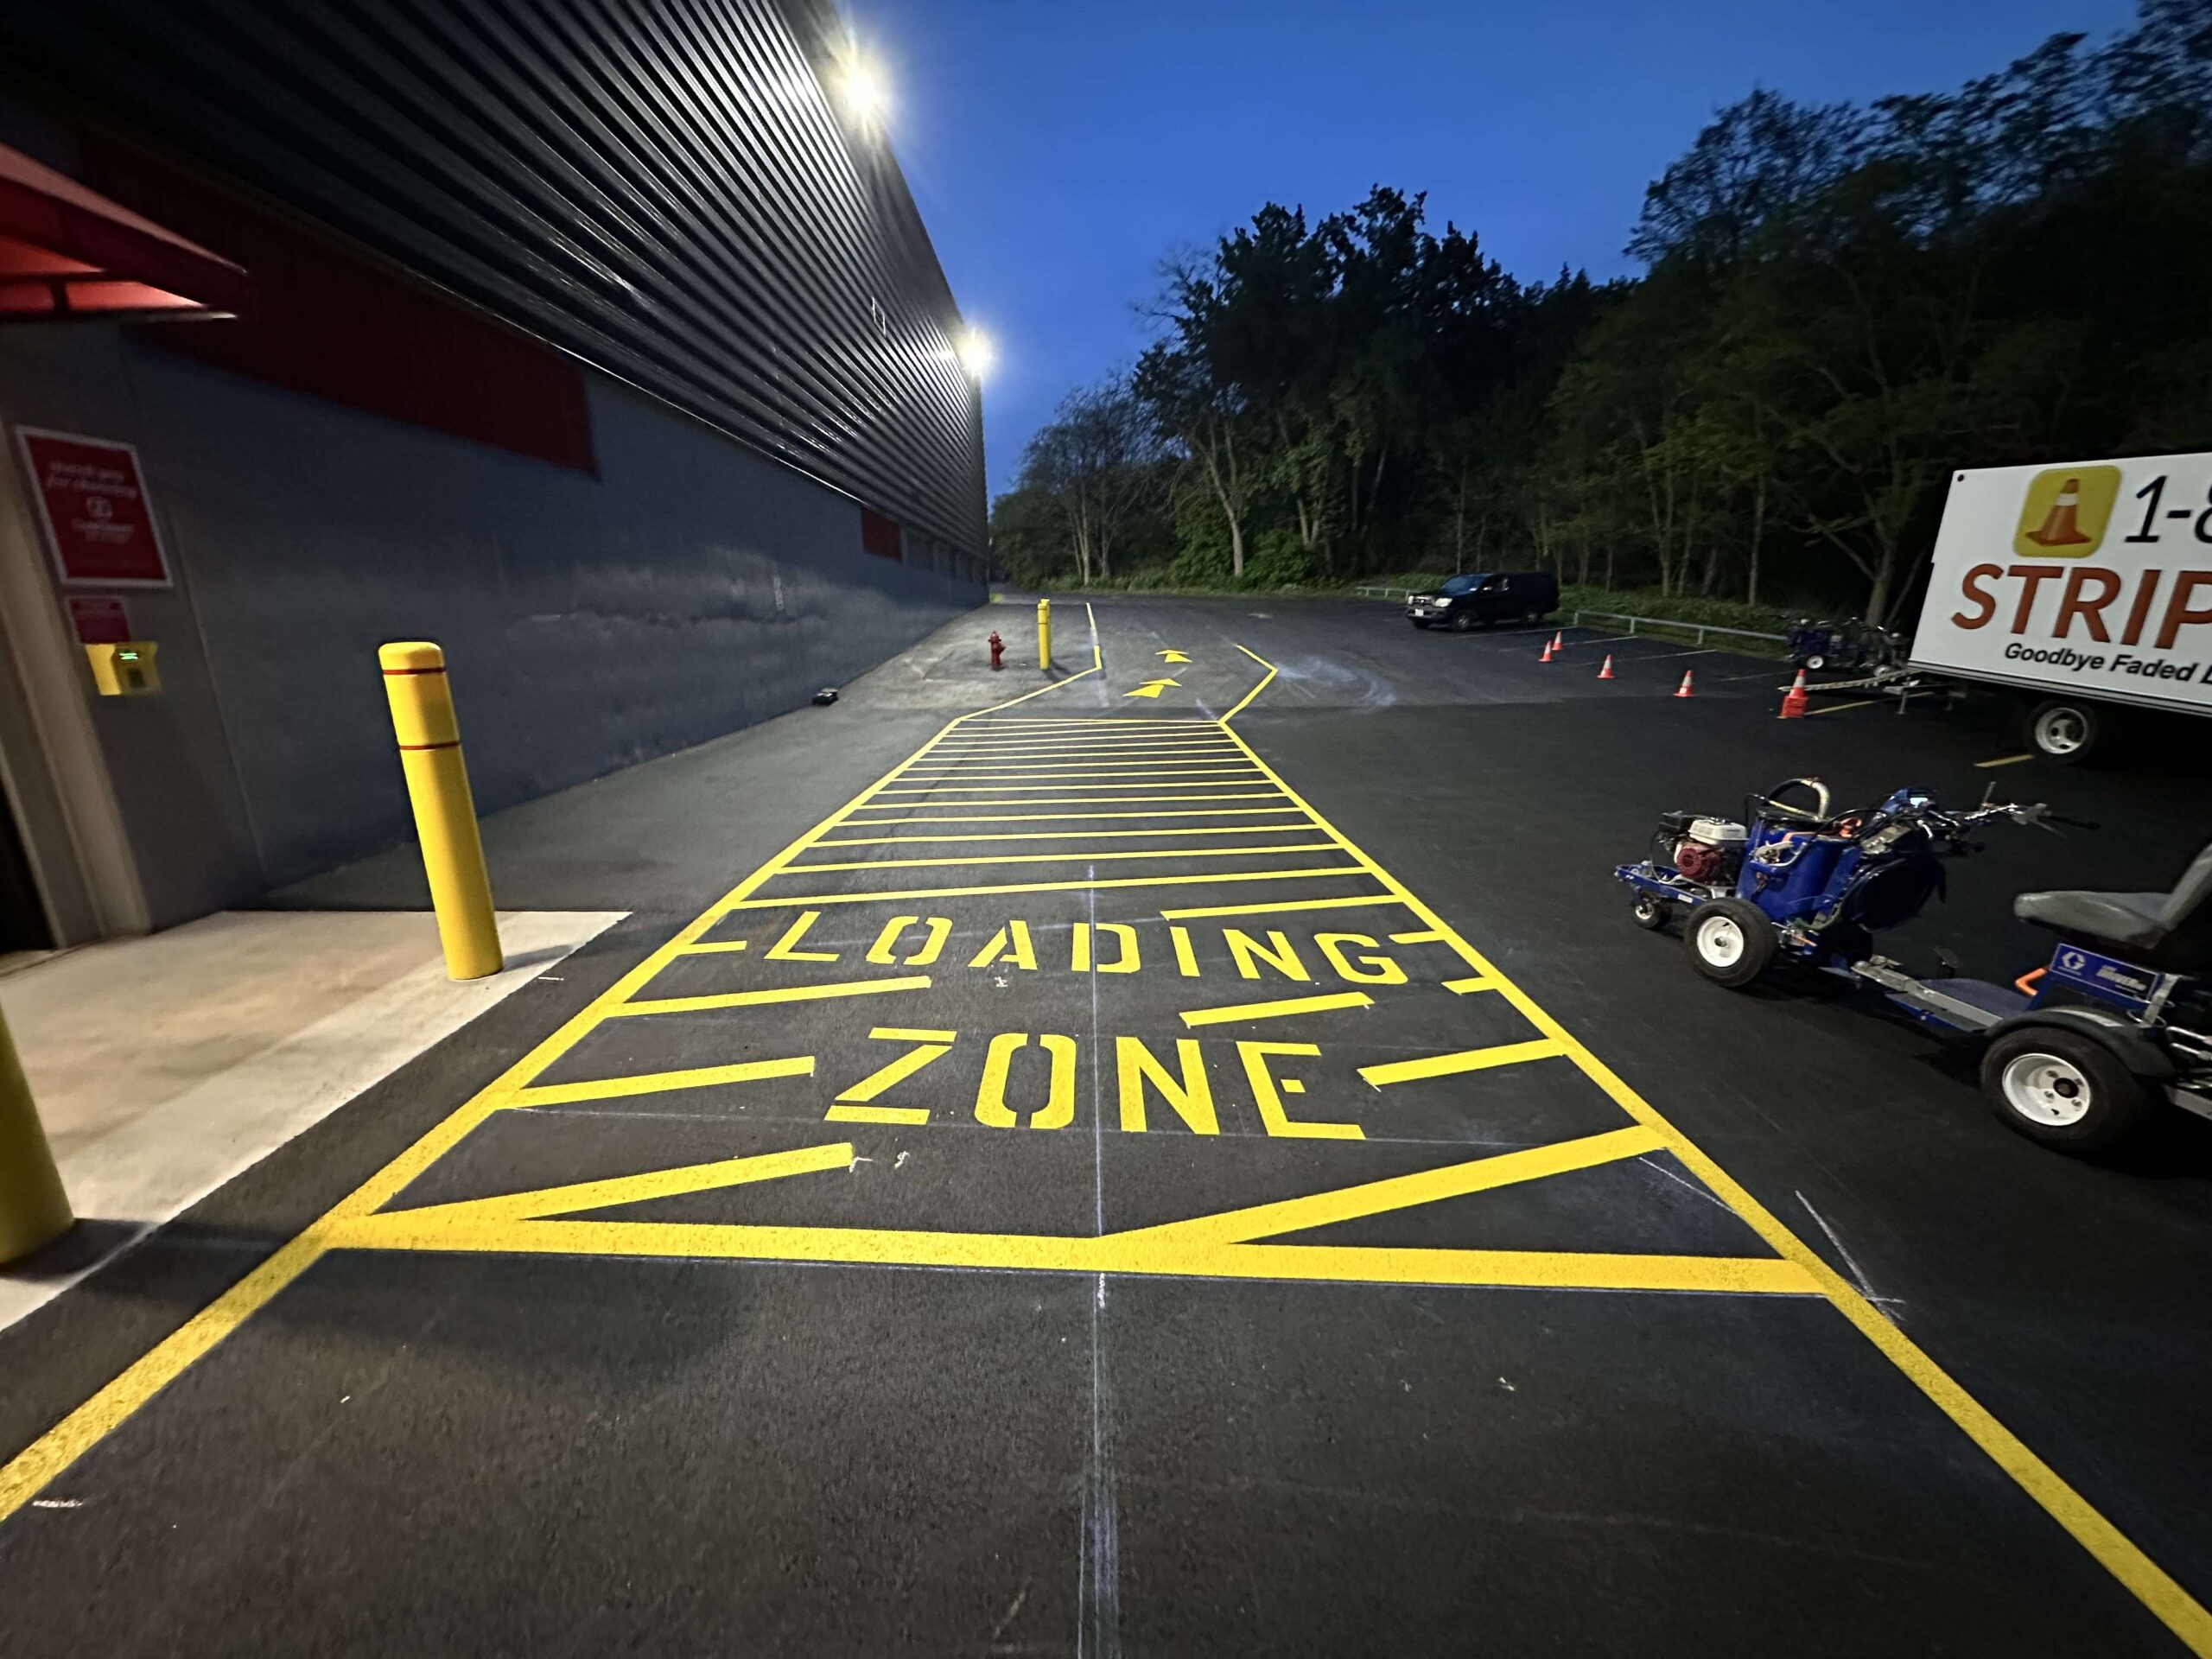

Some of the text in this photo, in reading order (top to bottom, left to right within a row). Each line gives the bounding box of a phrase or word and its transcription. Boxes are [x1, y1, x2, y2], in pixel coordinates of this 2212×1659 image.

[1951, 564, 2212, 650] STRIP
[2004, 642, 2106, 672] Goodbye
[2109, 654, 2199, 682] Faded
[765, 912, 1408, 985] LOADING
[825, 1028, 1366, 1141] ZONE
